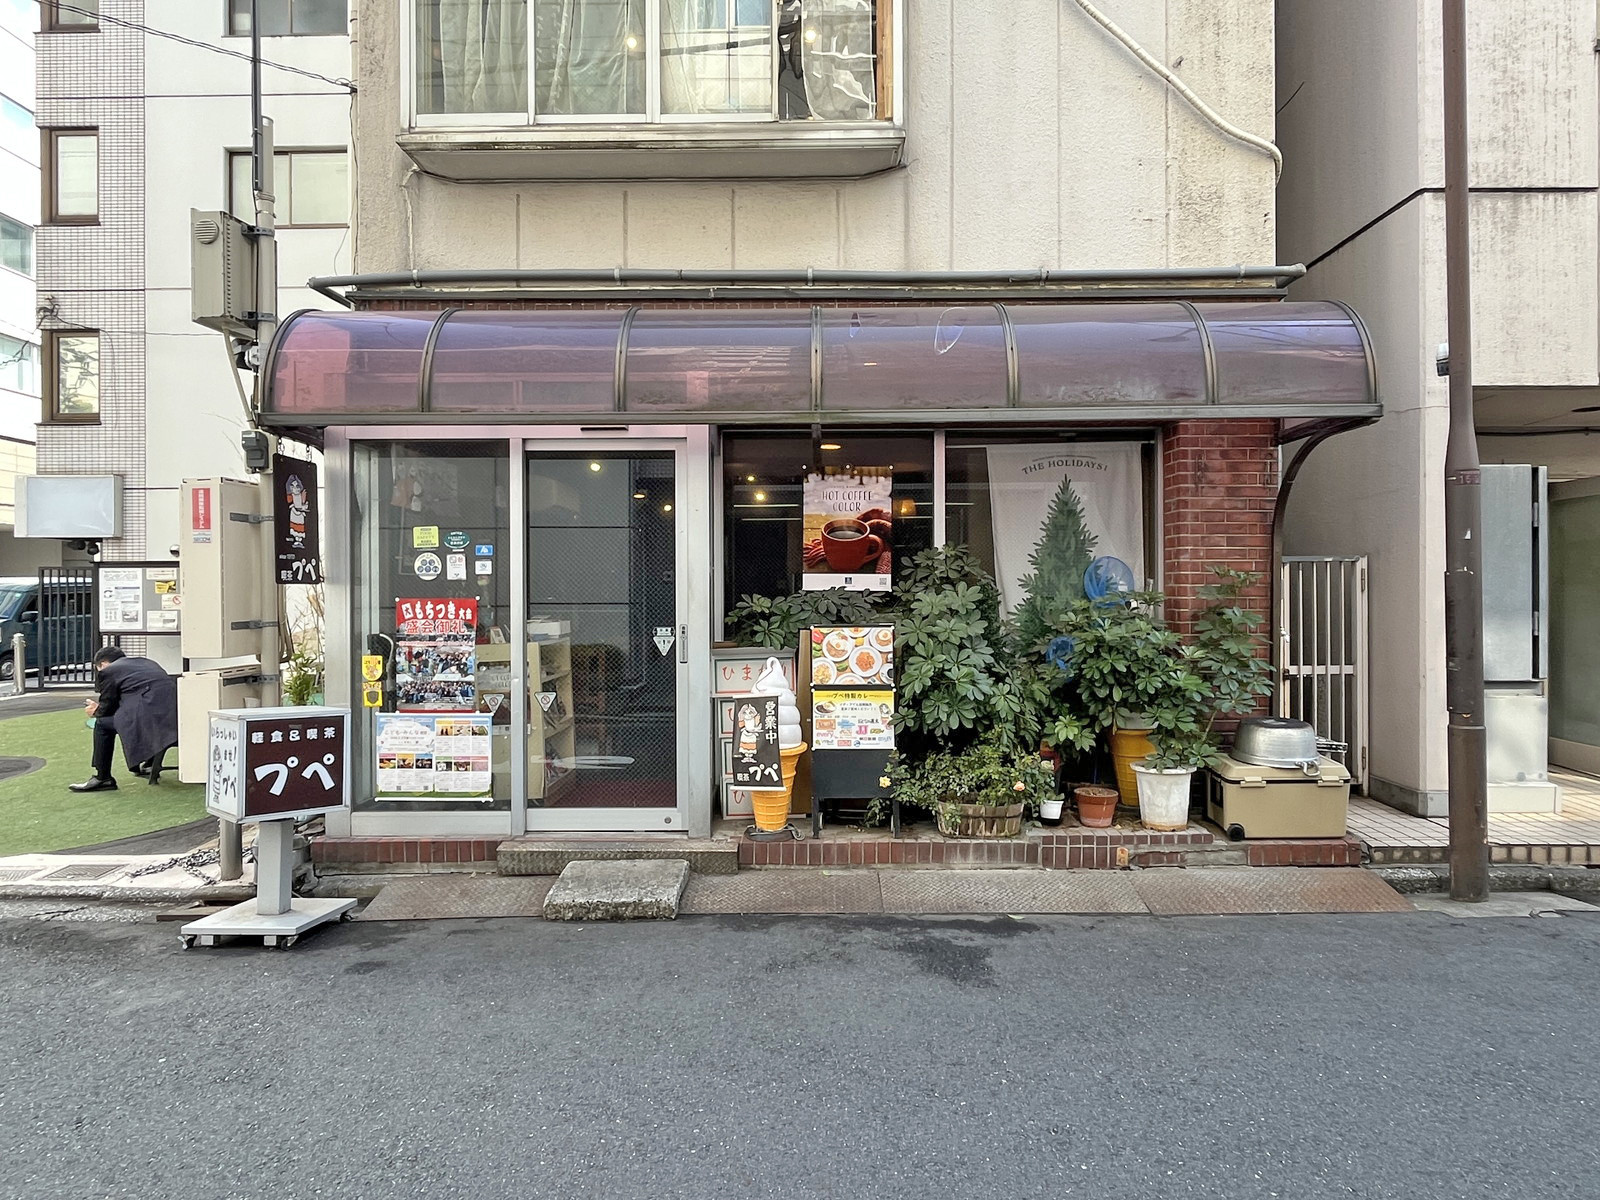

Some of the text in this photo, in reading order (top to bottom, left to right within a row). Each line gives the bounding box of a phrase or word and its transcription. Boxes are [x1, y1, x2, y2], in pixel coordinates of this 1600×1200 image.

[1021, 459, 1109, 475] THE HOLIDAYS!
[822, 491, 873, 501] HOT COFFEE
[832, 502, 861, 512] COLOR
[405, 619, 466, 635] 盛会御礼
[765, 700, 777, 745] 営業中
[254, 753, 335, 796] プペ
[748, 763, 779, 782] プペ
